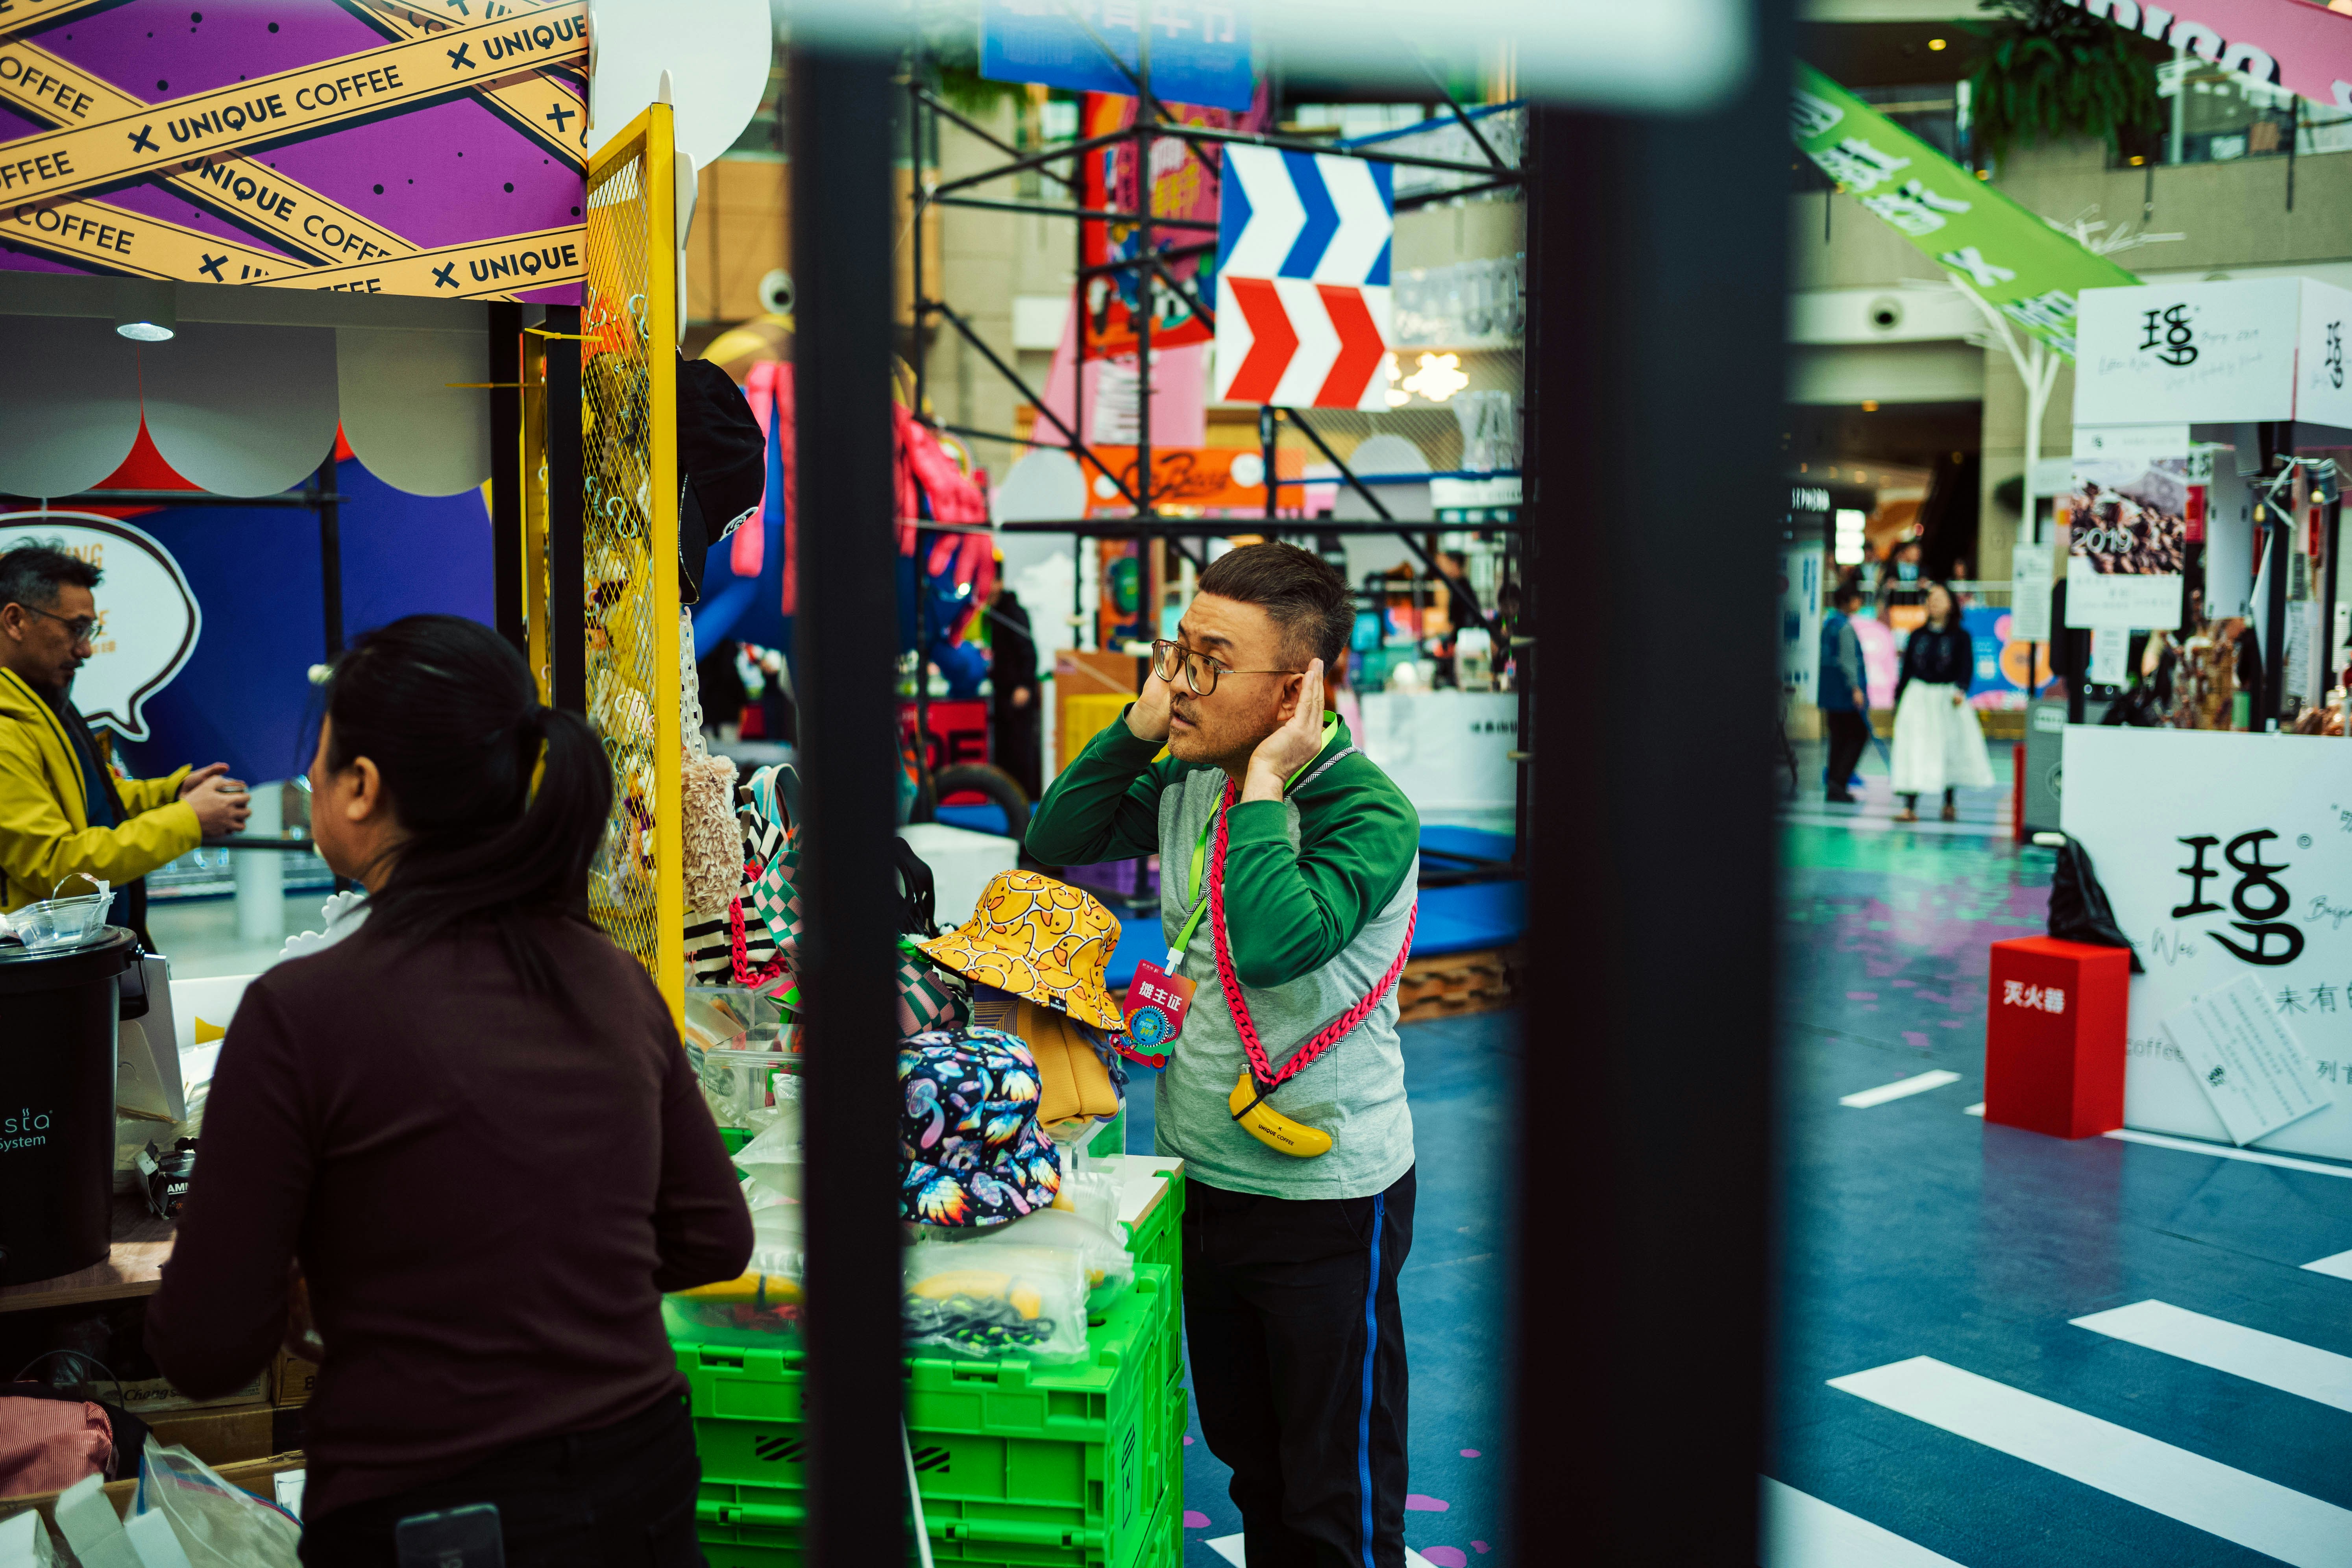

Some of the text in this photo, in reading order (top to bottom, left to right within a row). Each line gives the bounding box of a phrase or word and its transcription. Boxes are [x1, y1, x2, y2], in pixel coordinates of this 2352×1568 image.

[483, 15, 587, 60] UNIQUE
[167, 94, 287, 142] UNIQUE
[296, 65, 403, 111] COFFEE
[0, 150, 74, 189] FFEE
[13, 203, 135, 255] COFFEE
[303, 215, 392, 261] COFF
[469, 244, 579, 281] UNIQUE
[2071, 527, 2133, 554] 2019
[1139, 981, 1183, 1012] 摊主证
[2003, 980, 2066, 1015] 灭火器
[1258, 1124, 1294, 1146] UNIQUE COFFEE
